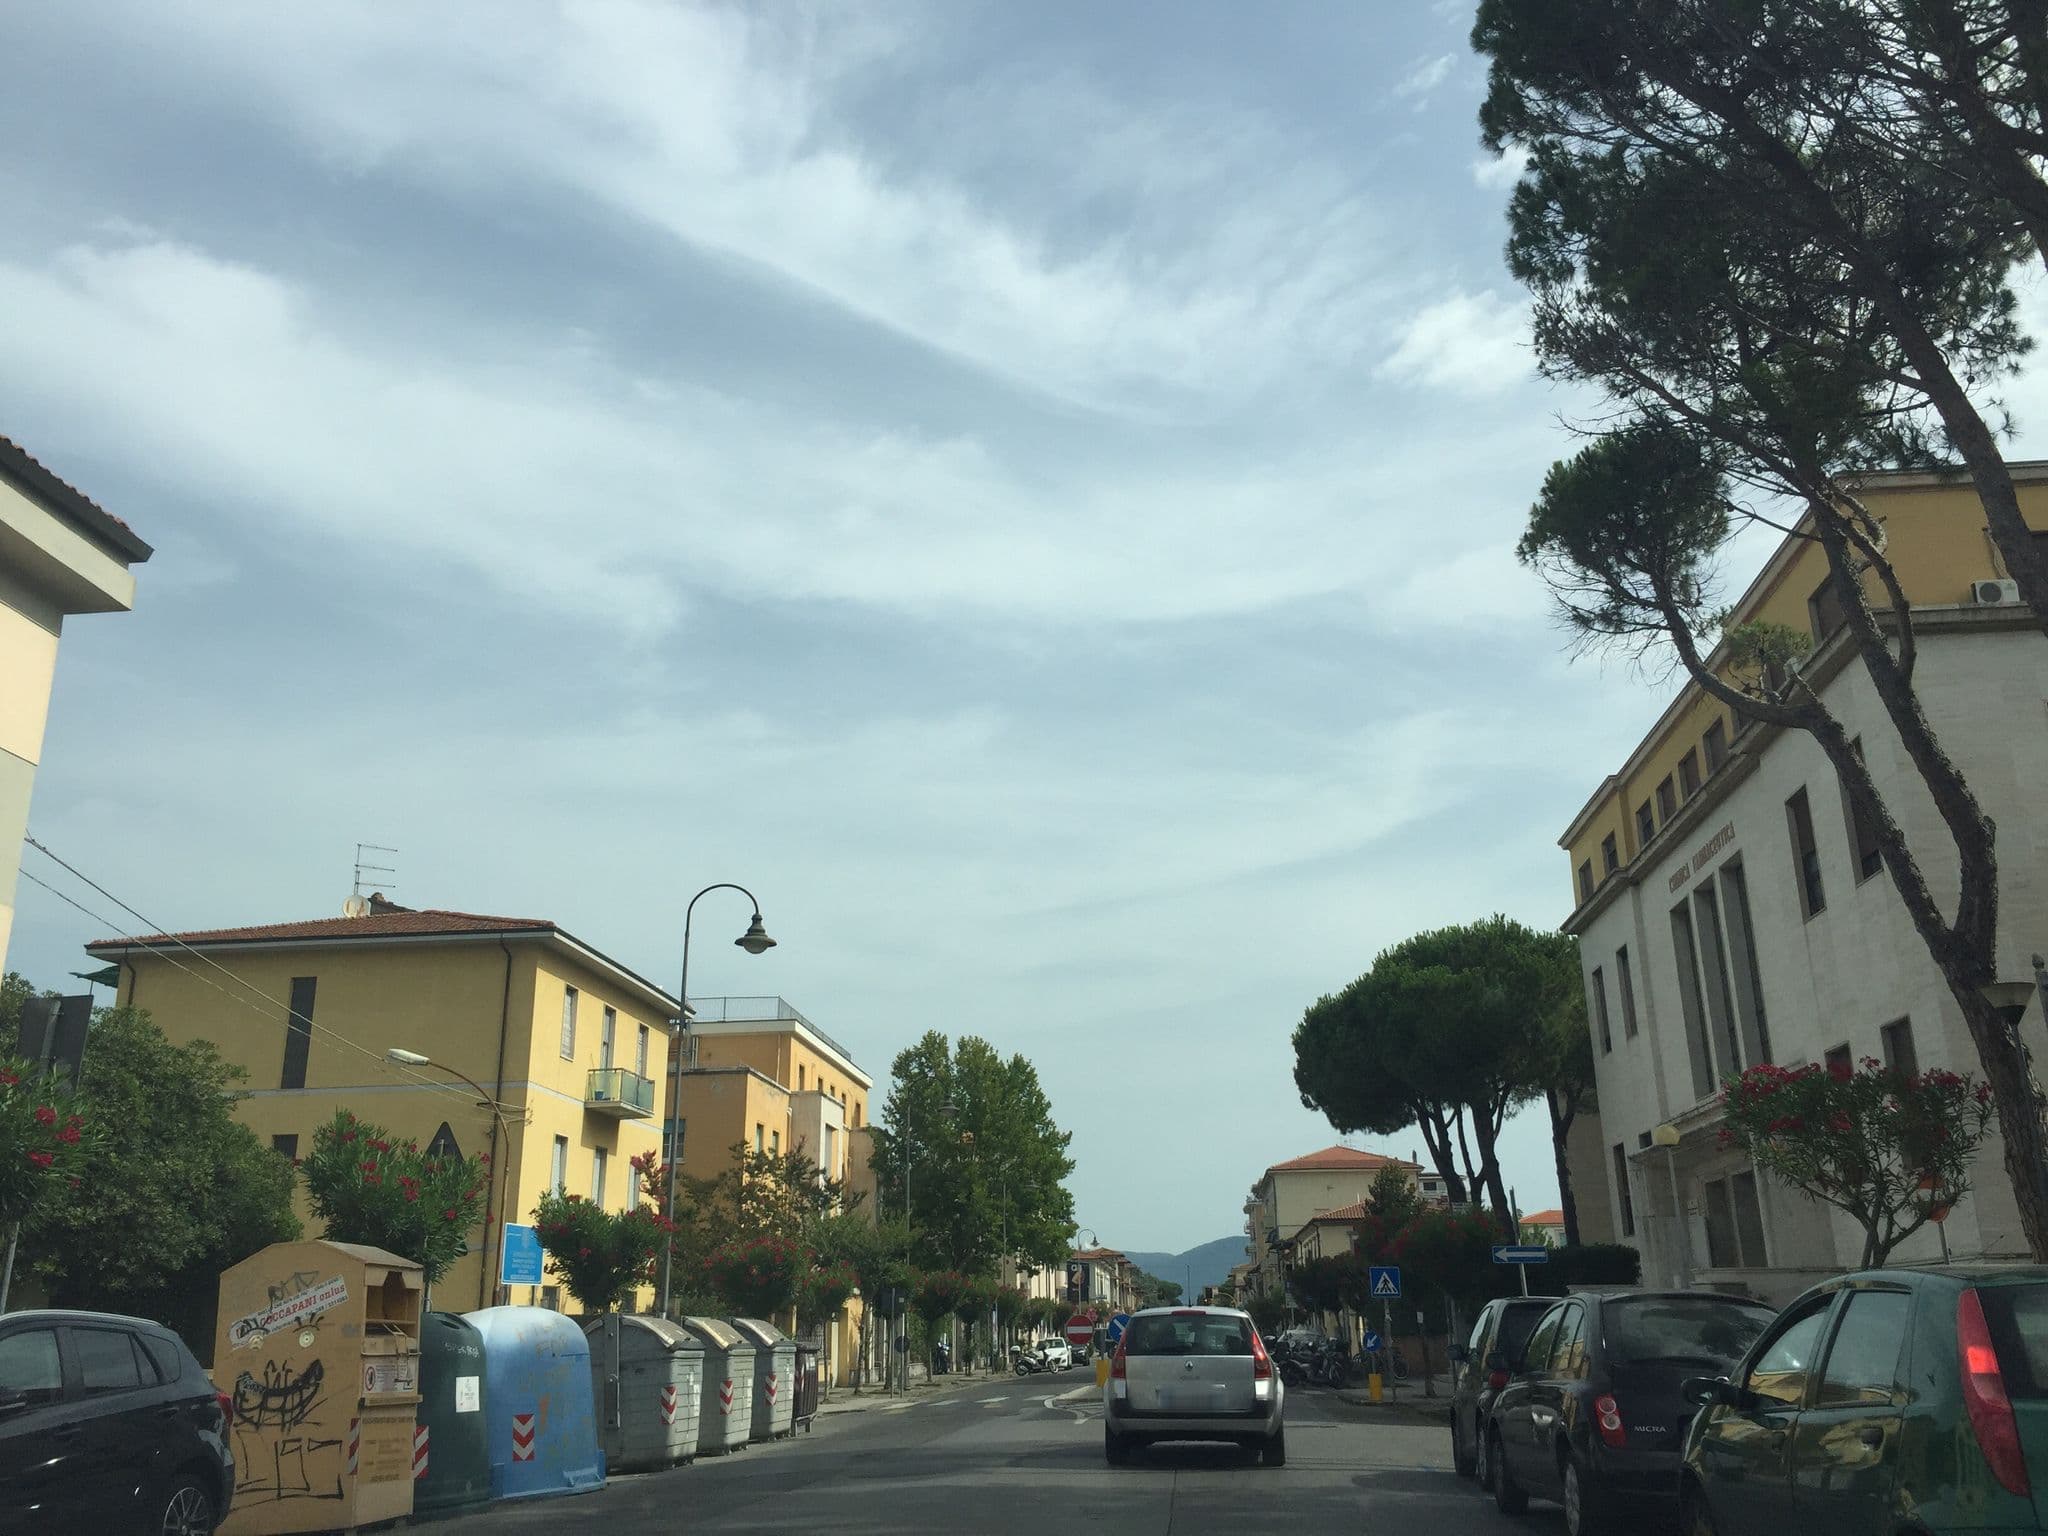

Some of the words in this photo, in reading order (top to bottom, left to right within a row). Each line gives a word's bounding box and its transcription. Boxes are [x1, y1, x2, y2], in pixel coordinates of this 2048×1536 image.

[259, 1296, 317, 1327] COCCAPANI
[319, 1284, 345, 1301] onlus
[1634, 1425, 1666, 1433] MICRA
